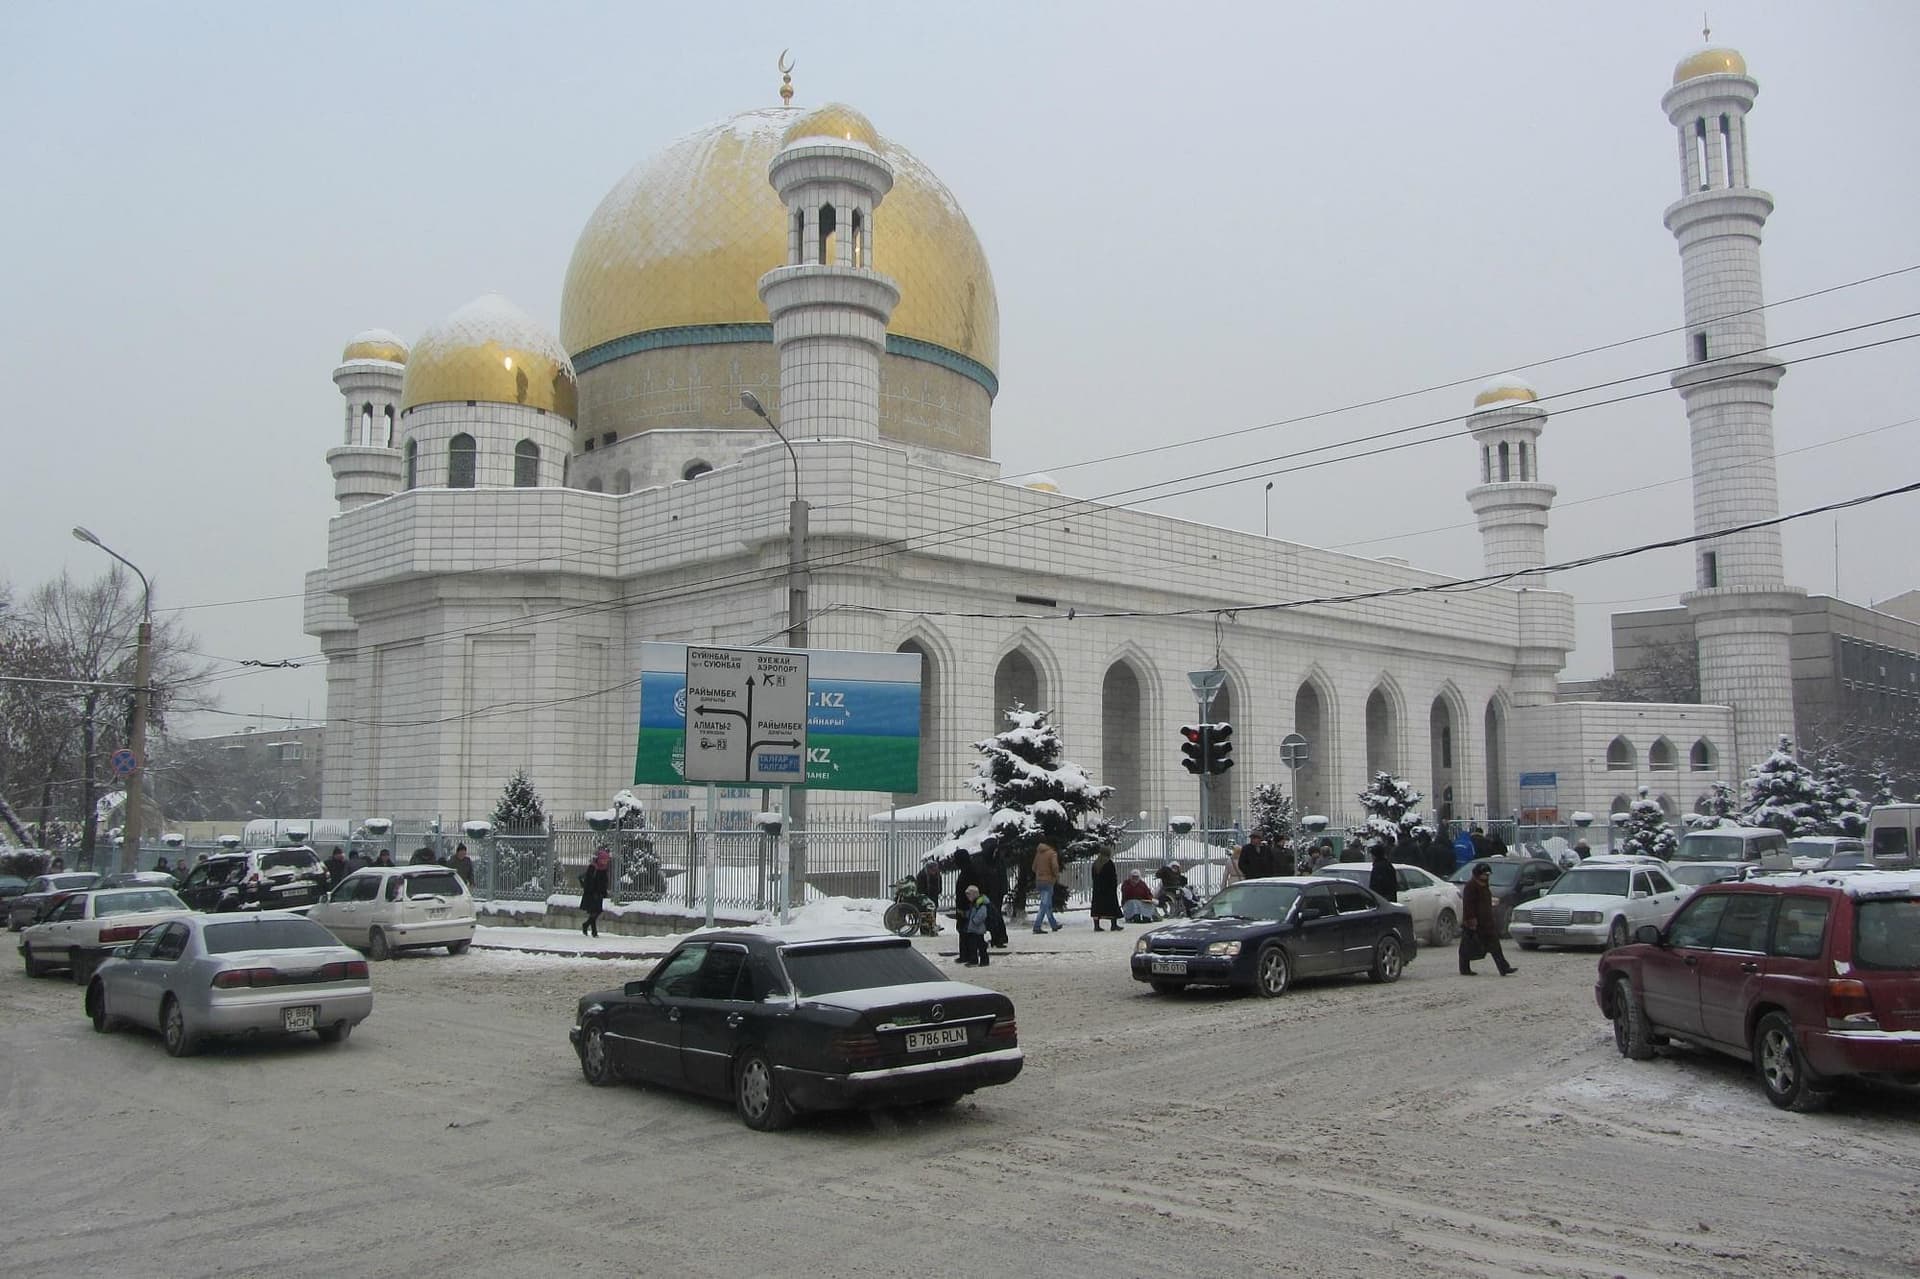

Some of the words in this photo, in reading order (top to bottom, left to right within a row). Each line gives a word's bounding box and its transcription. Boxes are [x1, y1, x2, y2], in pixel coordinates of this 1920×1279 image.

[703, 660, 741, 669] СУЮНБАЯ
[757, 656, 790, 665] ӘУЕЖАЙ
[757, 664, 798, 673] АЭРОПОРТ
[689, 687, 737, 698] РАЙЫМБЕК
[758, 720, 803, 731] РАЙЫМБЕК
[909, 1035, 917, 1047] B
[920, 1032, 940, 1045] 786
[941, 1028, 964, 1043] RLN
